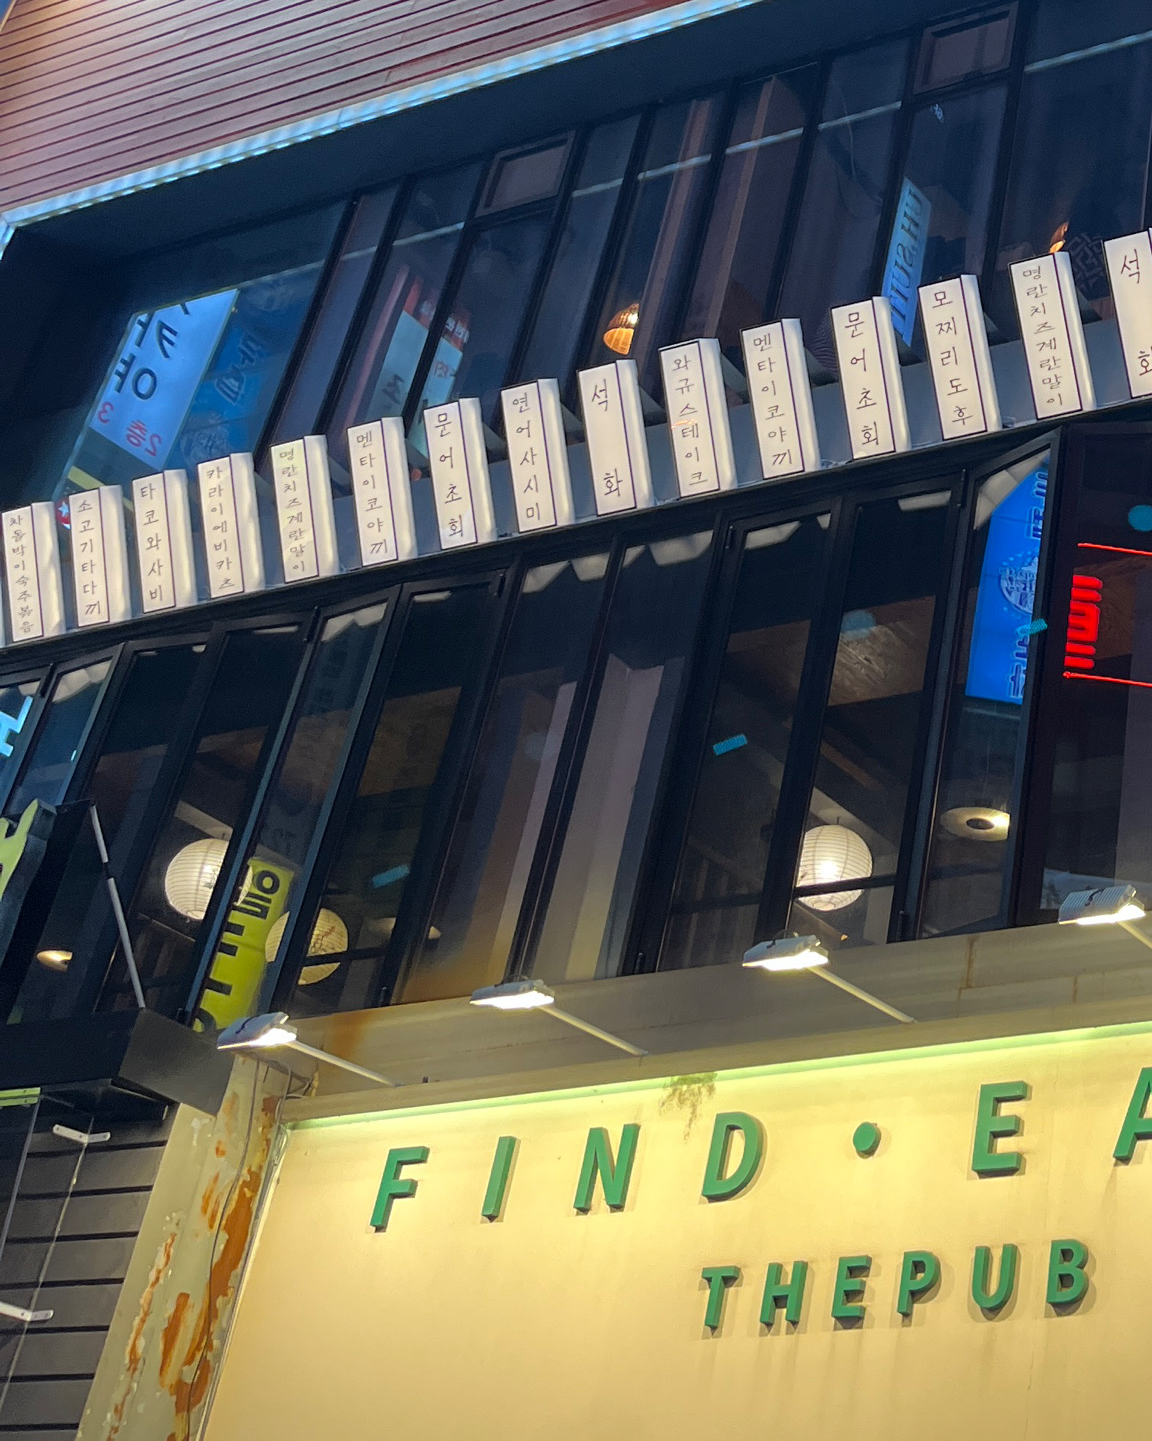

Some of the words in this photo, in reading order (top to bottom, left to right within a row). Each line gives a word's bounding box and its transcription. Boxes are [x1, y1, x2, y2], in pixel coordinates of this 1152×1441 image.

[672, 355, 708, 486] 와규스테이크
[753, 333, 793, 466] 멘타이코야끼
[844, 311, 880, 446] 문어초회
[932, 290, 974, 426] 모찌리도후
[356, 431, 389, 555] 멘타이코야끼
[434, 412, 464, 538] 문어초회
[512, 393, 541, 521] 연어사시미
[591, 379, 623, 498] 석화
[77, 499, 101, 616] 소고기타다끼
[140, 483, 163, 602] 타코와사비
[206, 466, 235, 590] 카라이에비카츠
[369, 1111, 764, 1232] FIND
